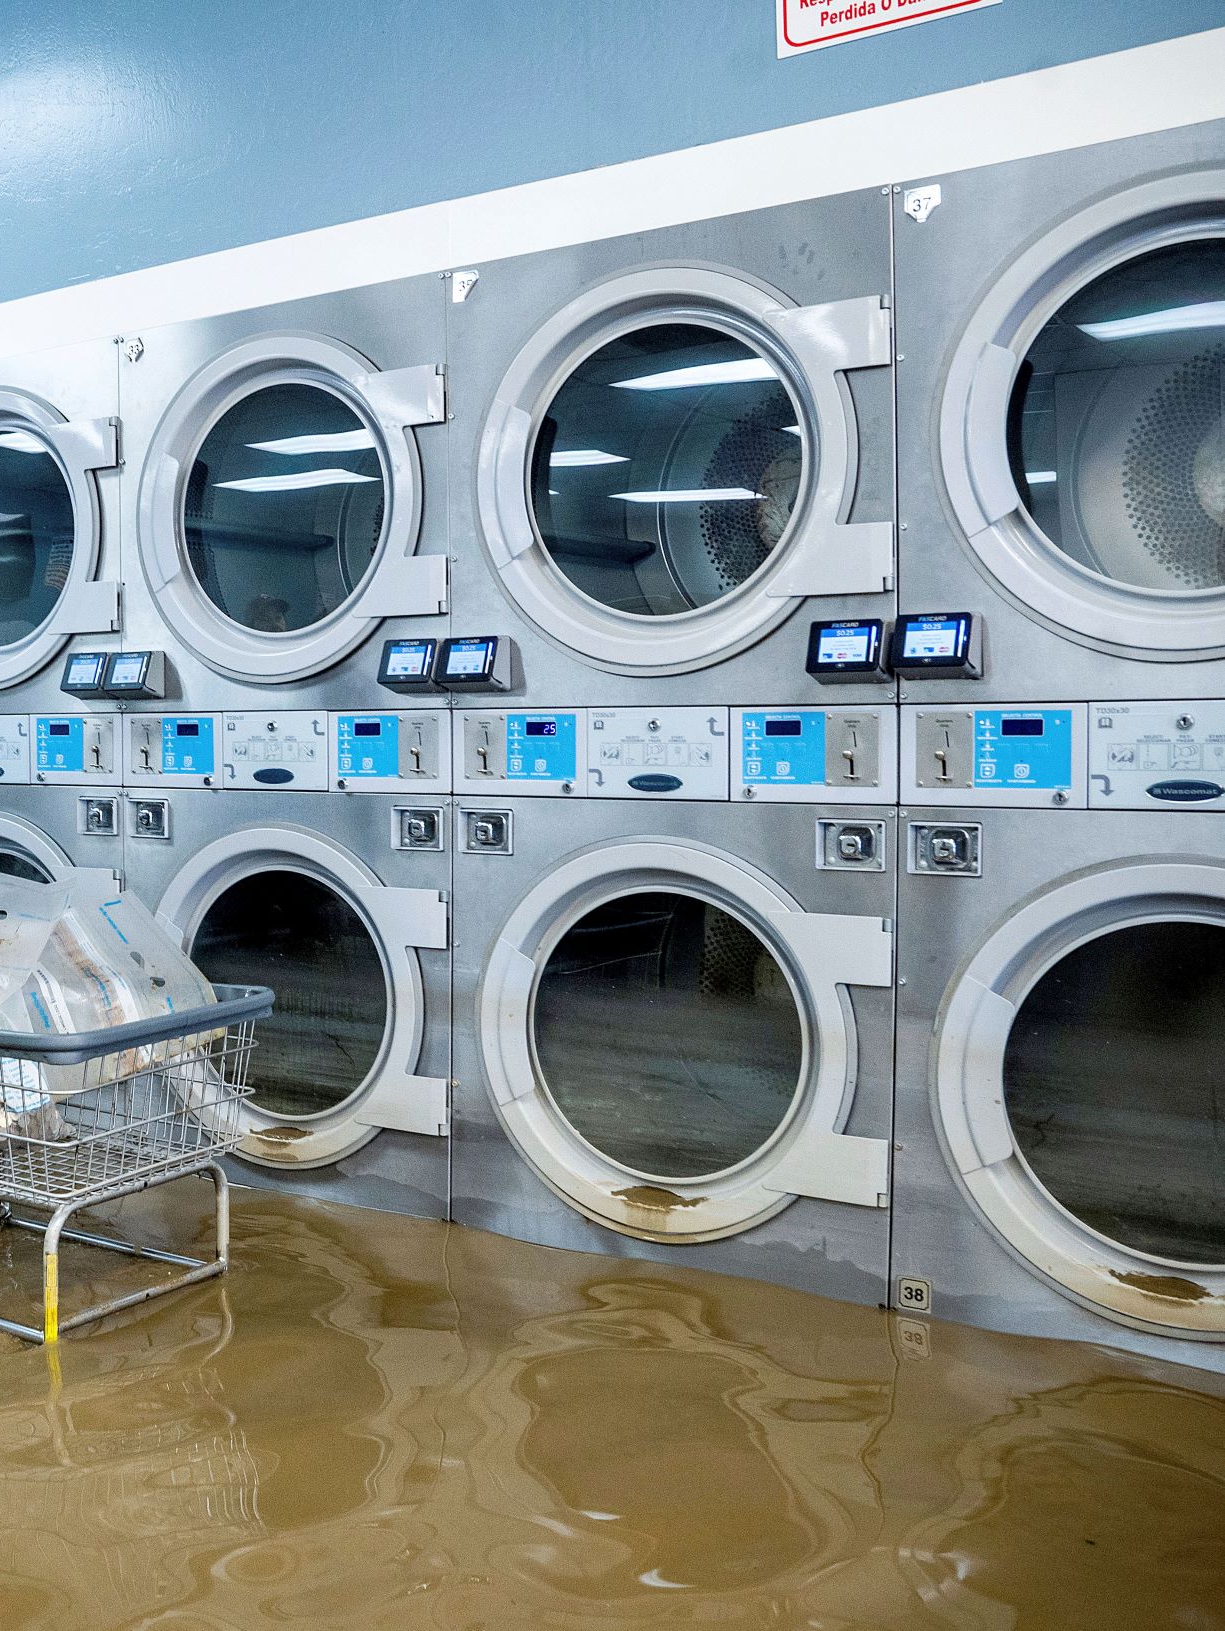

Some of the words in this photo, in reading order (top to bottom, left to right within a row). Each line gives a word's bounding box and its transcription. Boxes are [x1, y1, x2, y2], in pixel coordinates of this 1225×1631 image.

[820, 1, 876, 27] Perdida
[913, 197, 932, 212] 37
[543, 724, 556, 734] 25
[904, 1286, 924, 1302] 38
